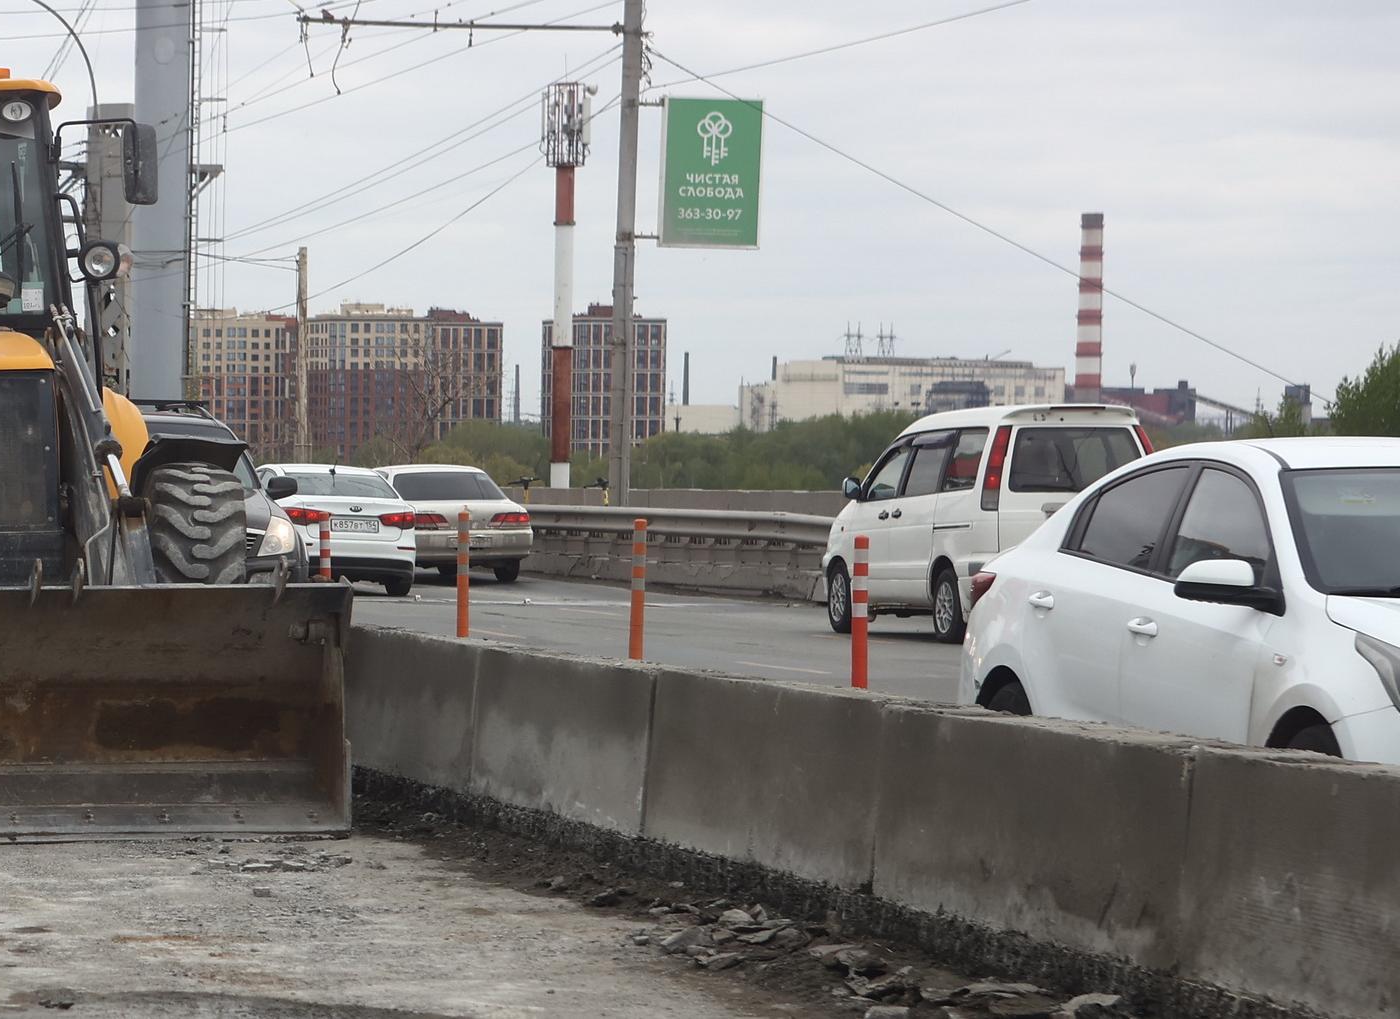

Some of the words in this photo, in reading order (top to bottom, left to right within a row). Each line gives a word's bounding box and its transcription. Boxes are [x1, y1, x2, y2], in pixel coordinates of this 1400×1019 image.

[686, 173, 739, 184] ЧИСТАЯ
[679, 186, 744, 199] СЛОБОДА
[677, 208, 742, 221] 363-30-97
